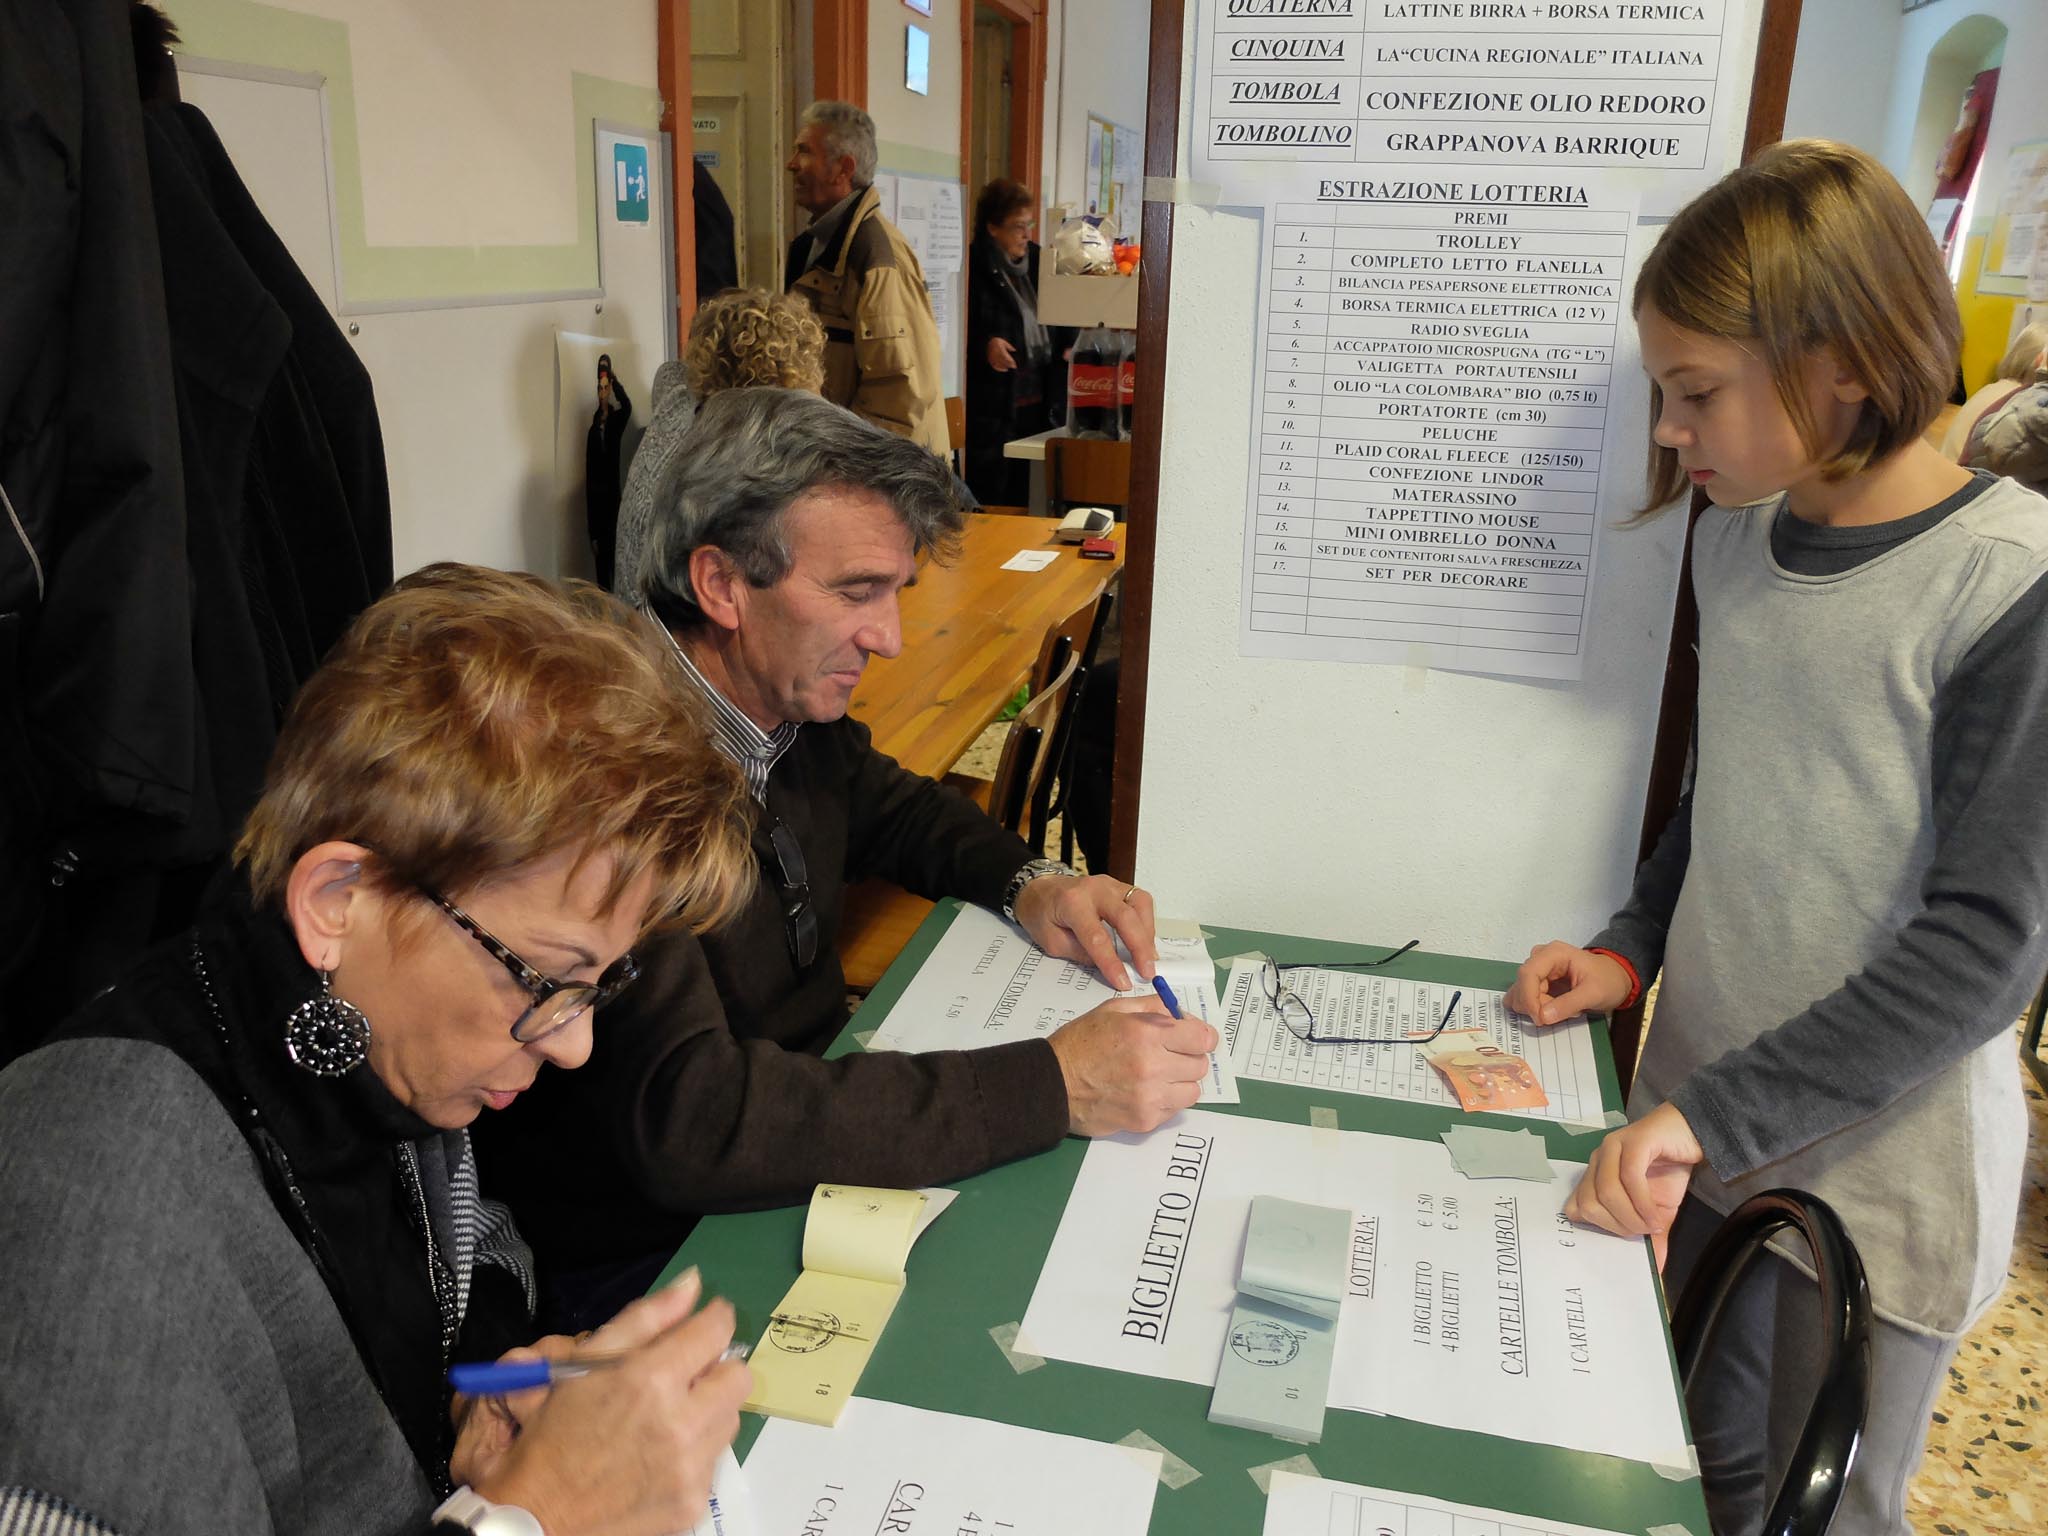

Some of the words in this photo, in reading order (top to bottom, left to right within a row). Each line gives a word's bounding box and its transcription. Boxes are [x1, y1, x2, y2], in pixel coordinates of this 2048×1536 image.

[1228, 0, 1353, 15] QUATERNA
[1384, 4, 1463, 18] LATTINE
[1469, 4, 1527, 19] BIRRA
[1532, 6, 1544, 17] +
[1548, 5, 1610, 19] BORSA
[1616, 5, 1705, 20] TERMICA
[1231, 39, 1345, 59] CINQUINA
[1611, 50, 1704, 65] ITALIANA
[1231, 82, 1341, 101] TOMBOLA
[1366, 92, 1523, 111] CONFEZIONE
[1530, 93, 1592, 113] OLIO
[1600, 94, 1706, 115] REDORO
[1216, 124, 1352, 143] TOMBOLINO
[1386, 133, 1547, 154] GRAPPANOVA
[1555, 136, 1680, 159] BARRIQUE
[1319, 180, 1463, 201] ESTRAZIONE
[1470, 184, 1588, 204] LOTTERIA
[1454, 212, 1509, 226] PREMI
[1437, 234, 1522, 250] TROLLEY
[1297, 254, 1306, 264] 2.
[1350, 255, 1444, 270] COMPLETO
[1452, 257, 1507, 272] LETTO
[1516, 260, 1604, 275] FLANELLA
[1296, 276, 1305, 287] 3.
[1338, 277, 1405, 290] BILANCIA
[1409, 279, 1508, 294] PESAPERSONE
[1511, 283, 1613, 297] ELETTRONICA
[1294, 298, 1304, 308] 4.
[1342, 299, 1392, 313] BORSA
[1396, 301, 1466, 315] TERMICA
[1471, 304, 1558, 318] ELETTRICA
[1565, 307, 1586, 320] (12
[1590, 308, 1606, 321] V)
[1292, 320, 1301, 329] 5.
[1411, 324, 1460, 337] RADIO
[1462, 325, 1530, 339] SVEGLIA
[1291, 339, 1300, 348] 6.
[1333, 341, 1433, 355] ACCAPPATOIO
[1436, 345, 1539, 359] MICROSPUGNA
[1291, 358, 1299, 367] 7.
[1357, 360, 1444, 375] VALIGETTA
[1455, 365, 1577, 380] PORTAUTENSILI
[1289, 379, 1297, 388] 8.
[1333, 380, 1371, 393] OLIO
[1515, 389, 1542, 400] BIO
[1287, 400, 1296, 409] 9.
[1378, 403, 1488, 420] PORTATORTE
[1496, 409, 1521, 422] (cm
[1525, 409, 1547, 424] 30)
[1281, 420, 1295, 430] 10.
[1422, 427, 1498, 442] PELUCHE
[1335, 443, 1382, 457] PLAID
[1386, 446, 1442, 461] CORAL
[1446, 450, 1509, 464] FLEECE
[1521, 452, 1584, 470] (125/150)
[1279, 461, 1292, 471] 12.
[1369, 466, 1473, 483] CONFEZIONE
[1482, 472, 1544, 486] LINDOR
[1277, 481, 1291, 491] 13.
[1392, 488, 1517, 506] MATERASSINO
[1276, 502, 1290, 511] 14.
[1275, 522, 1288, 531] 15.
[1366, 507, 1474, 525] TAPPETTINO
[1478, 513, 1540, 529] MOUSE
[1274, 541, 1287, 551] 16.
[1345, 526, 1385, 540] MINI
[1389, 528, 1487, 546] OMBRELLO
[1495, 534, 1557, 550] DONNA
[1272, 561, 1286, 571] 17.
[1316, 545, 1340, 555] SET
[1342, 547, 1367, 557] DUE
[1370, 549, 1455, 563] CONTENITORI
[1457, 555, 1498, 566] SALVA
[1501, 557, 1582, 571] FRESCHEZZA
[1365, 567, 1395, 580] SET
[1402, 570, 1432, 583] PER
[1440, 573, 1528, 588] DECORARE
[971, 938, 1005, 976] CARTELLA
[1231, 972, 1250, 1007] LOTTERIA
[986, 982, 1027, 1031] TOMBOLA:
[1248, 996, 1260, 1014] PREMI
[1417, 1193, 1434, 1216] 1.50
[1442, 1196, 1459, 1219] 5.00
[1417, 1219, 1433, 1227] €
[1442, 1222, 1459, 1231] €
[1121, 1192, 1192, 1343] BIGLIETTO
[1166, 1133, 1208, 1182] BLU
[1495, 1196, 1519, 1276] TOMBOLA:
[1560, 1240, 1576, 1248] €
[1349, 1214, 1376, 1298] LOTTERIA:
[1414, 1260, 1433, 1336] BIGLIETTO
[1441, 1271, 1460, 1342] BIGLIETTI
[1497, 1278, 1525, 1375] CARTELLE
[1565, 1287, 1591, 1364] CARTELLA
[1441, 1344, 1456, 1353] 4
[815, 1382, 832, 1397] 18
[963, 1511, 984, 1523] 4
